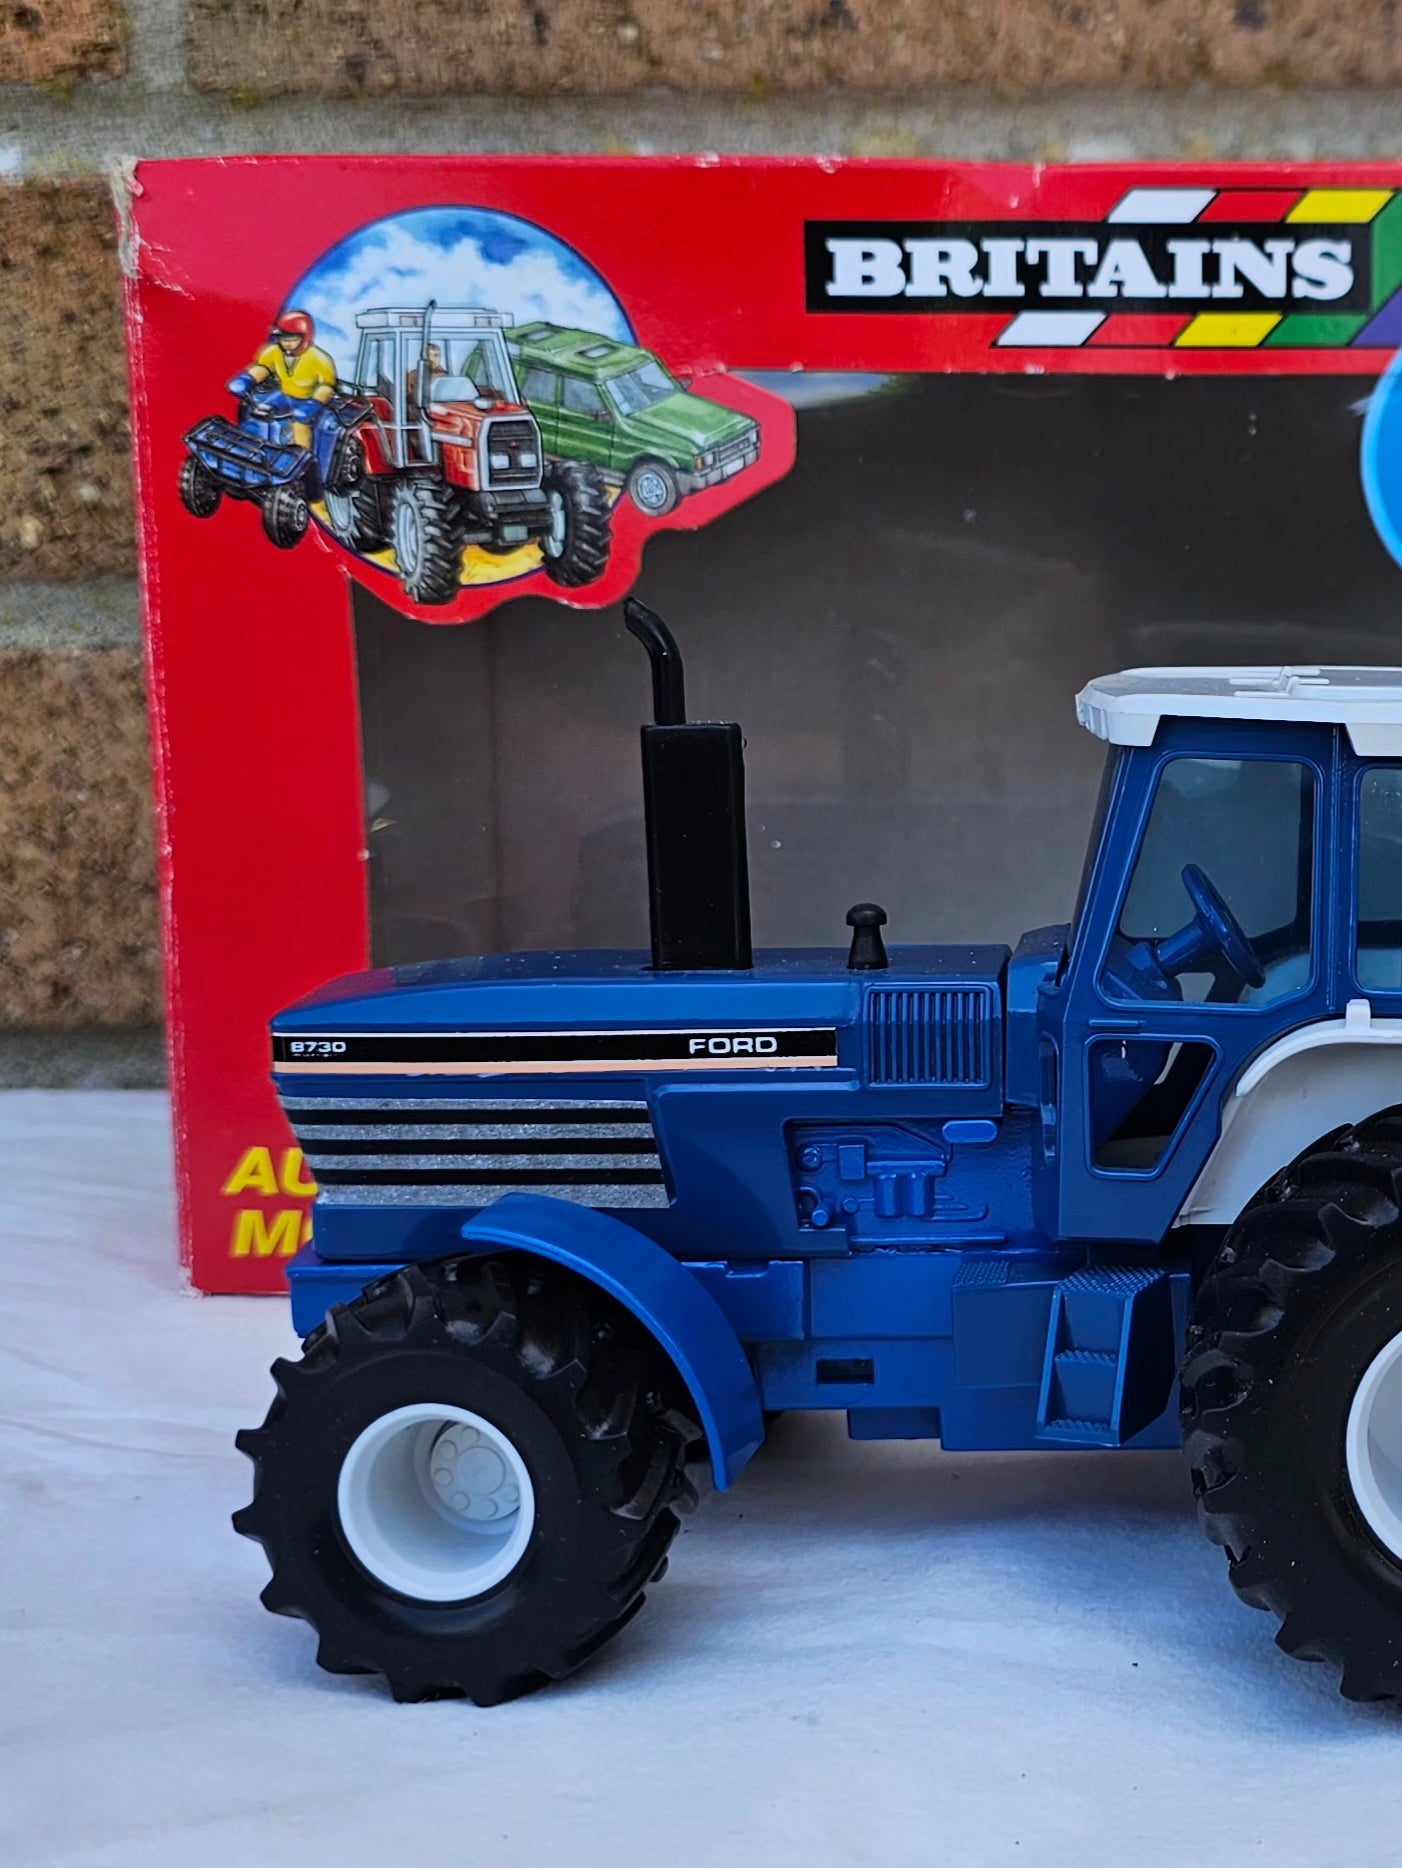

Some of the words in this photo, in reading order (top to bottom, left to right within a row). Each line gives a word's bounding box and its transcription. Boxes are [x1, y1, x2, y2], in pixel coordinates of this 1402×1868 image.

[825, 237, 1355, 301] BRITAINS
[290, 1041, 347, 1053] 8730
[688, 1035, 777, 1054] FORD
